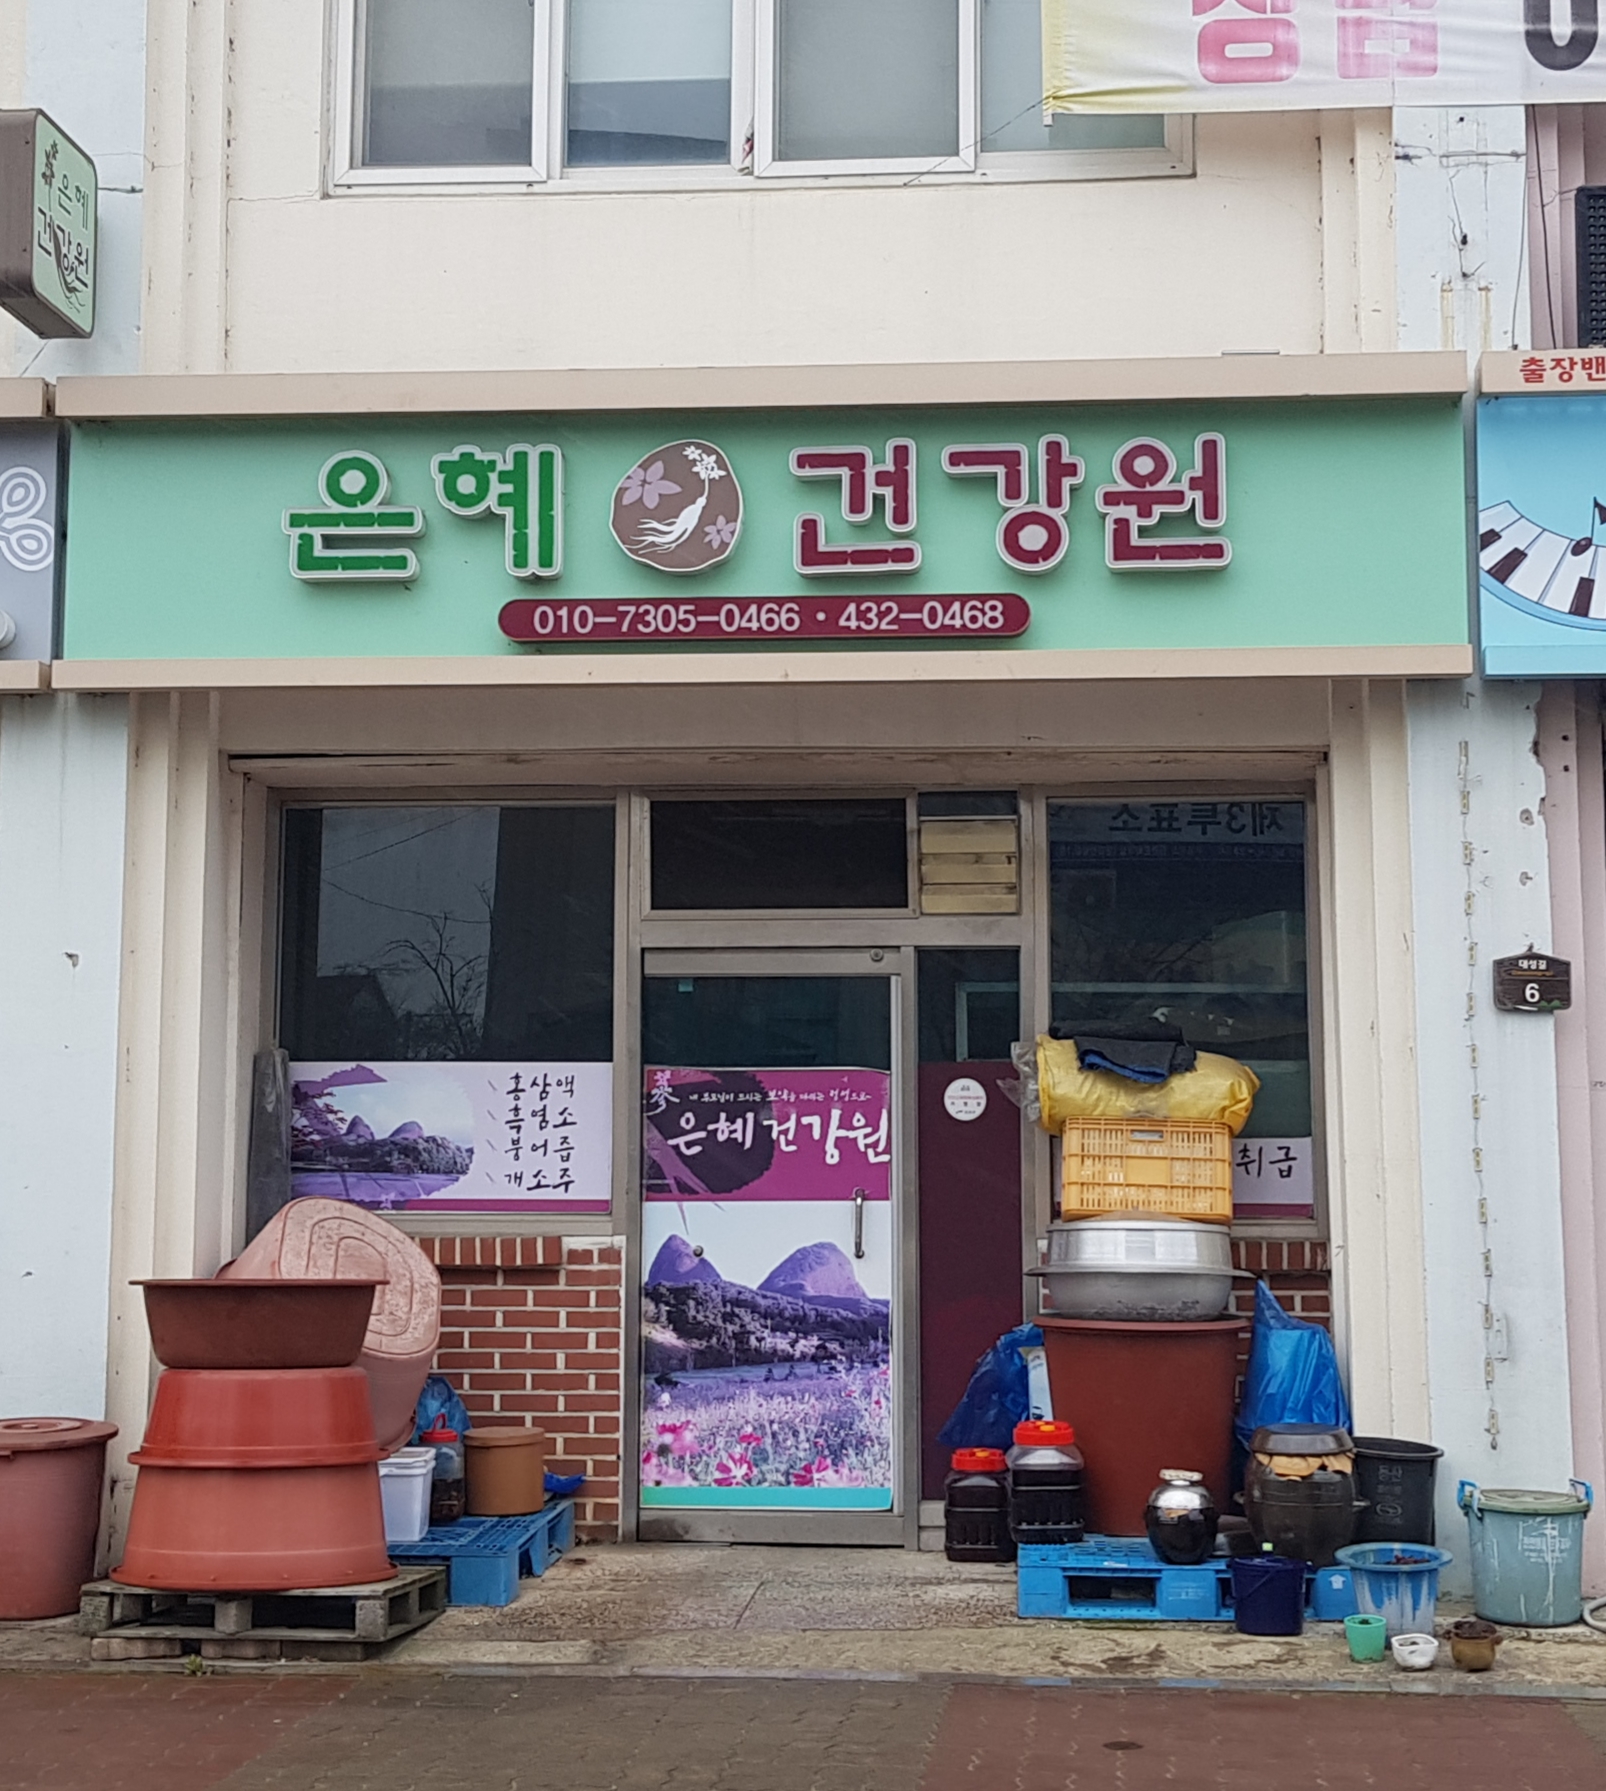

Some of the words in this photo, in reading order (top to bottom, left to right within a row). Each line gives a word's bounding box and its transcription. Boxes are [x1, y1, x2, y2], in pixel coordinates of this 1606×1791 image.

[57, 174, 89, 231] 은혜
[37, 206, 89, 289] 건강원
[281, 443, 563, 581] 은혜
[789, 432, 1233, 578] 건강원
[532, 602, 801, 635] 010-7305-0466
[837, 599, 1005, 631] 432-0468
[1524, 982, 1541, 1004] 6
[505, 1072, 576, 1102] 홍삼액
[504, 1103, 578, 1135] 흑염소
[667, 1111, 755, 1157] 은혜
[762, 1108, 891, 1165] 건강원
[504, 1135, 576, 1163] 붕어즙
[1235, 1143, 1298, 1179] 취급
[503, 1168, 576, 1194] 개소주
